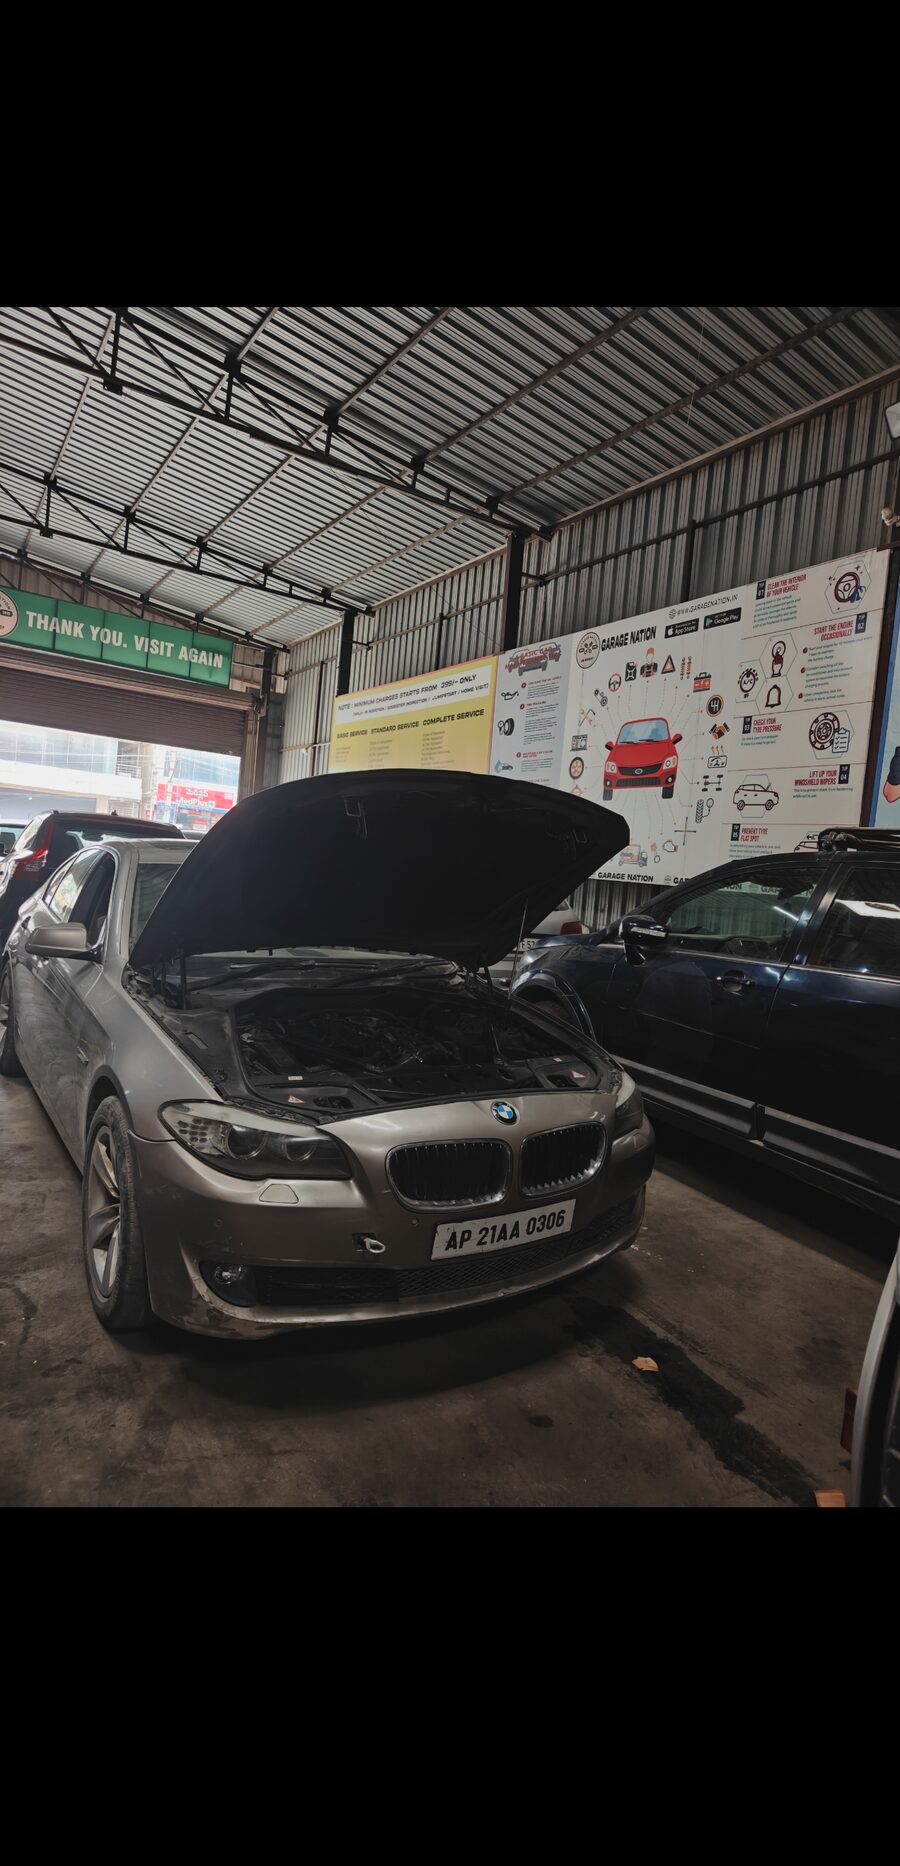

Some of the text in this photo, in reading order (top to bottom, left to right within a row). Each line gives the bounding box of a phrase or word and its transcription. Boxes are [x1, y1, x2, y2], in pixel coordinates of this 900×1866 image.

[714, 616, 729, 625] Google
[729, 613, 739, 623] Play
[684, 625, 696, 633] Store
[26, 610, 224, 669] THANK YOU. VISIT AGAIN
[601, 632, 628, 651] GARAGE
[630, 626, 657, 645] NATION
[354, 699, 375, 708] MINIMUM
[376, 694, 399, 705] CHARGES
[400, 688, 420, 698] STARTS
[421, 683, 438, 694] FROM
[459, 674, 477, 684] ONLY
[422, 709, 485, 726] COMPLETE SERVICE
[371, 721, 419, 735] STANDARD SERVICE
[598, 872, 626, 880] GARAGE
[627, 873, 654, 882] NATION
[445, 1209, 566, 1250] AP 21AA 0306
